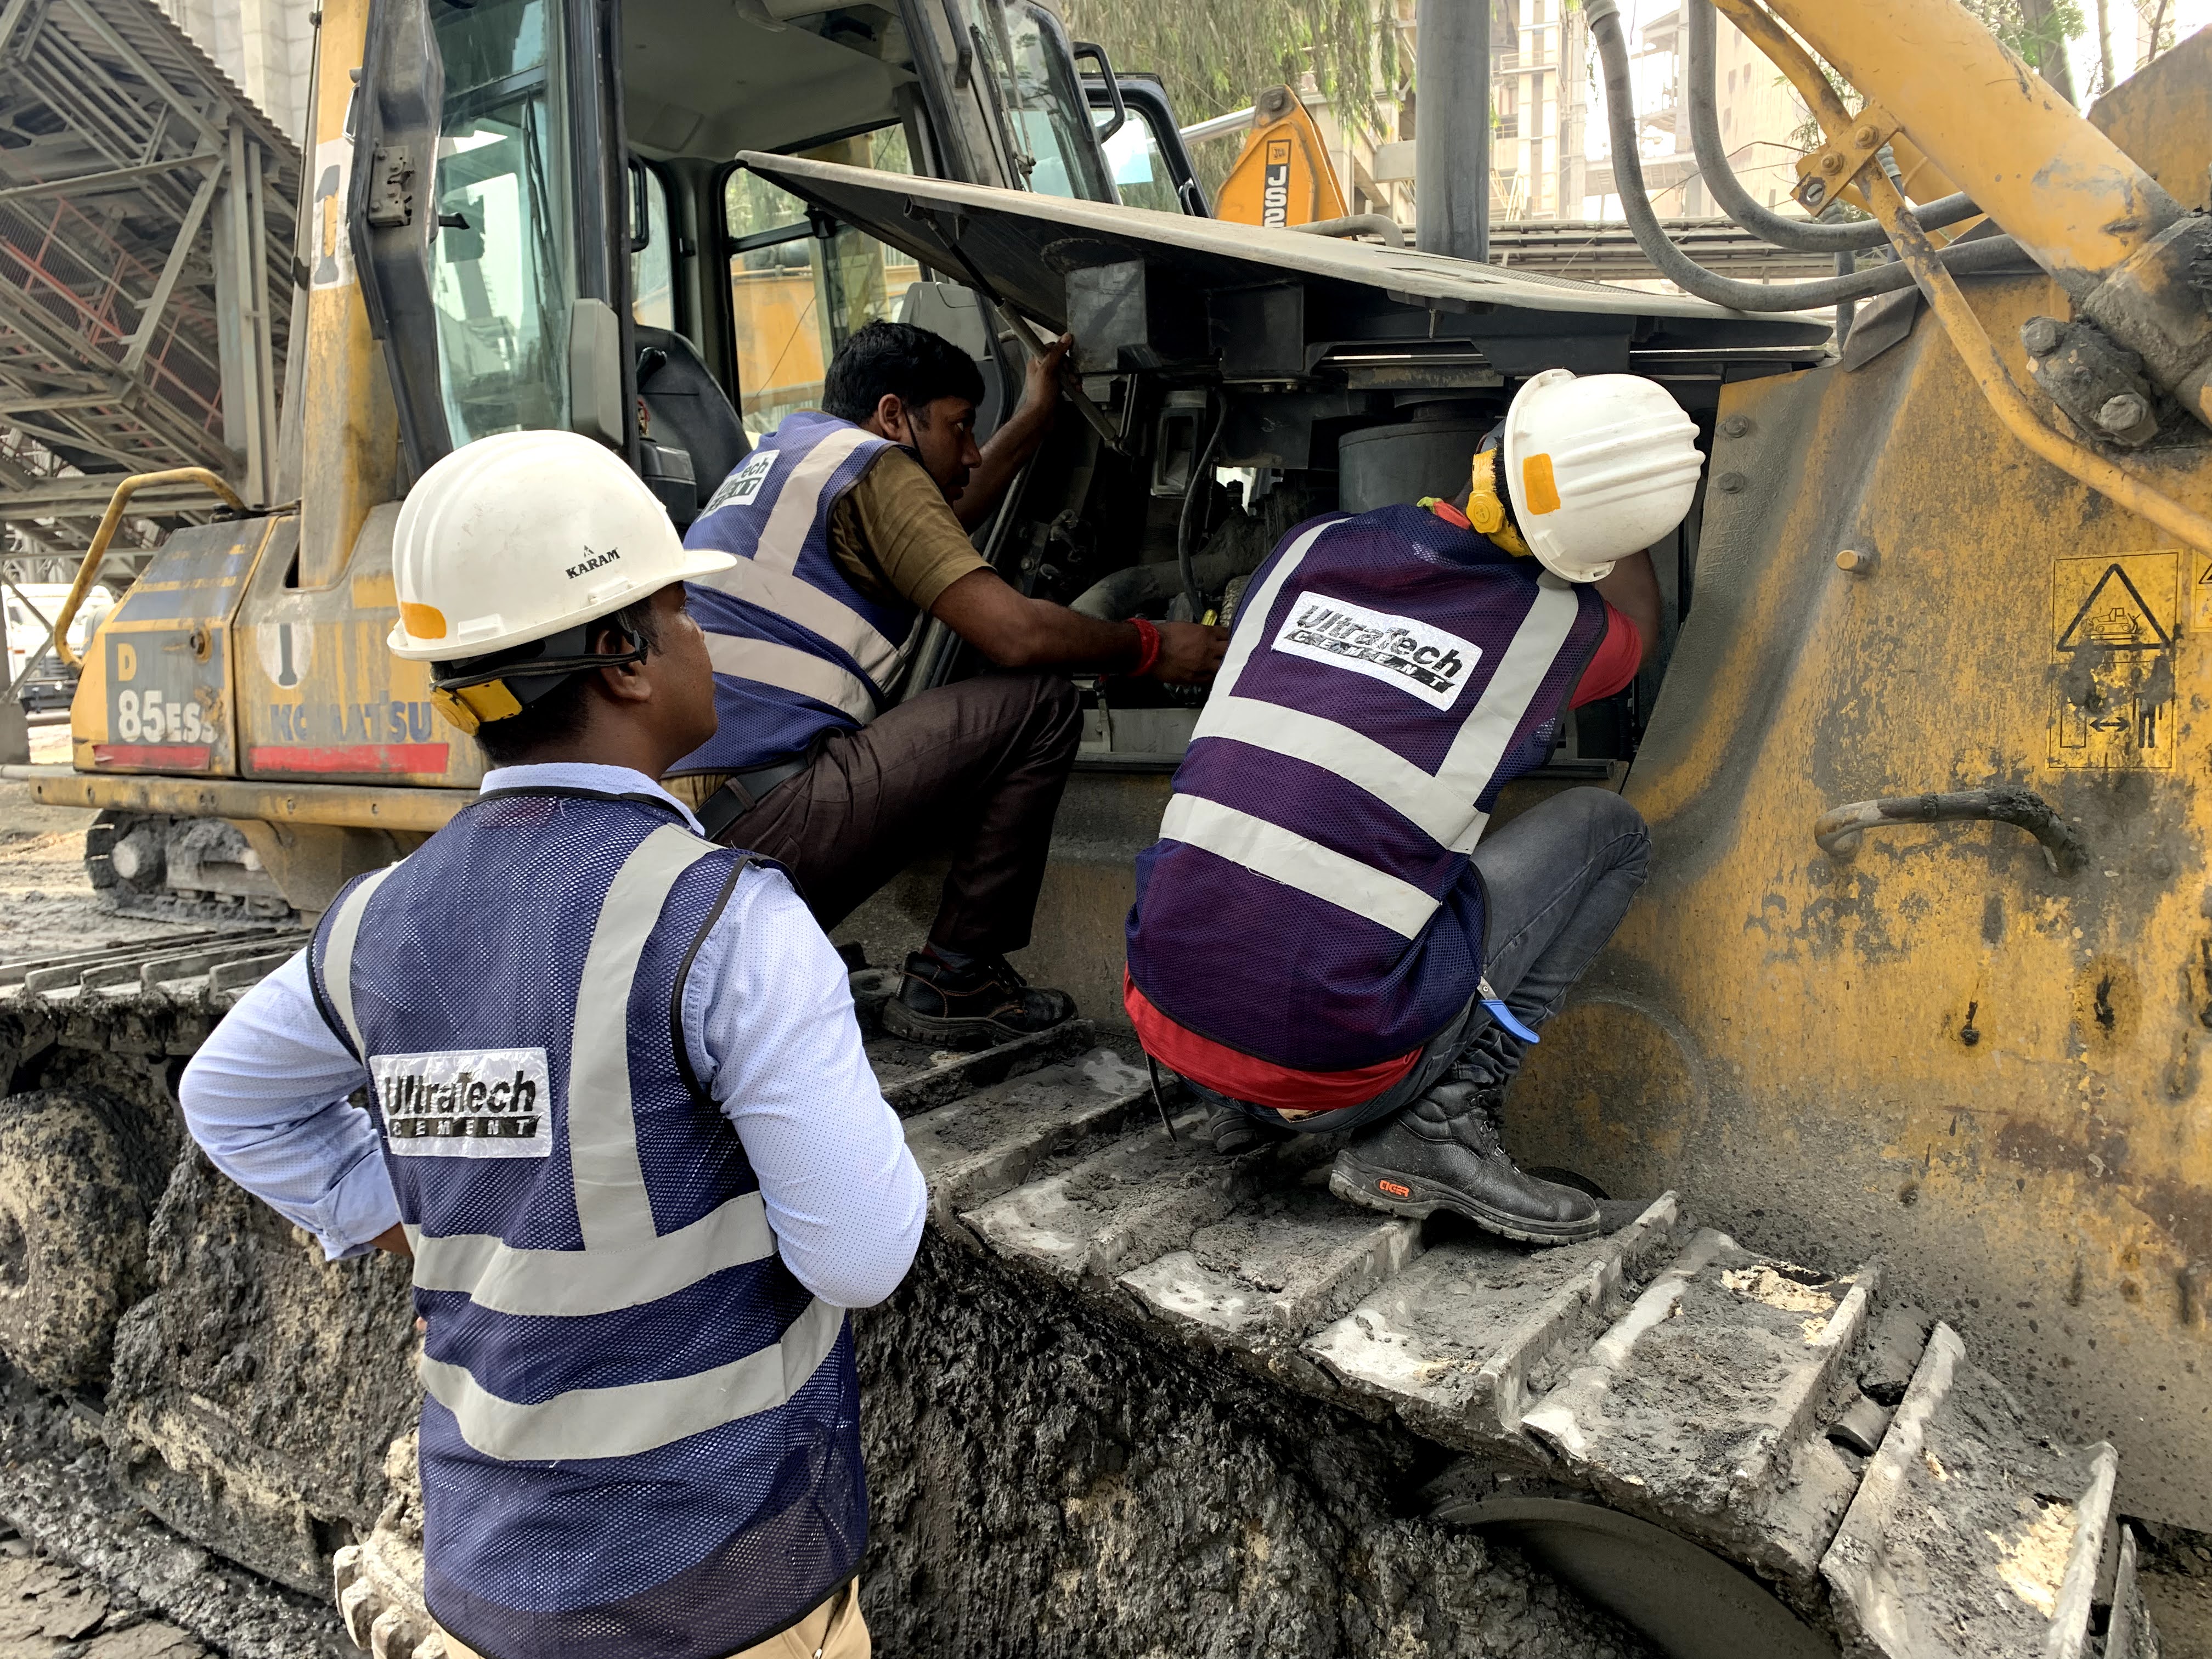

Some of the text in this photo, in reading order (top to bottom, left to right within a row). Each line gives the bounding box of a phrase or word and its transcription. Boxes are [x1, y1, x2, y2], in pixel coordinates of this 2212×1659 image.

[565, 549, 620, 579] KARAM
[117, 643, 137, 681] D
[1294, 629, 1444, 687] CEMENT
[1297, 605, 1463, 678] UltraTech
[269, 701, 432, 743] KOATSU
[385, 1070, 536, 1115] UltraTech
[391, 1118, 532, 1137] CEMENT
